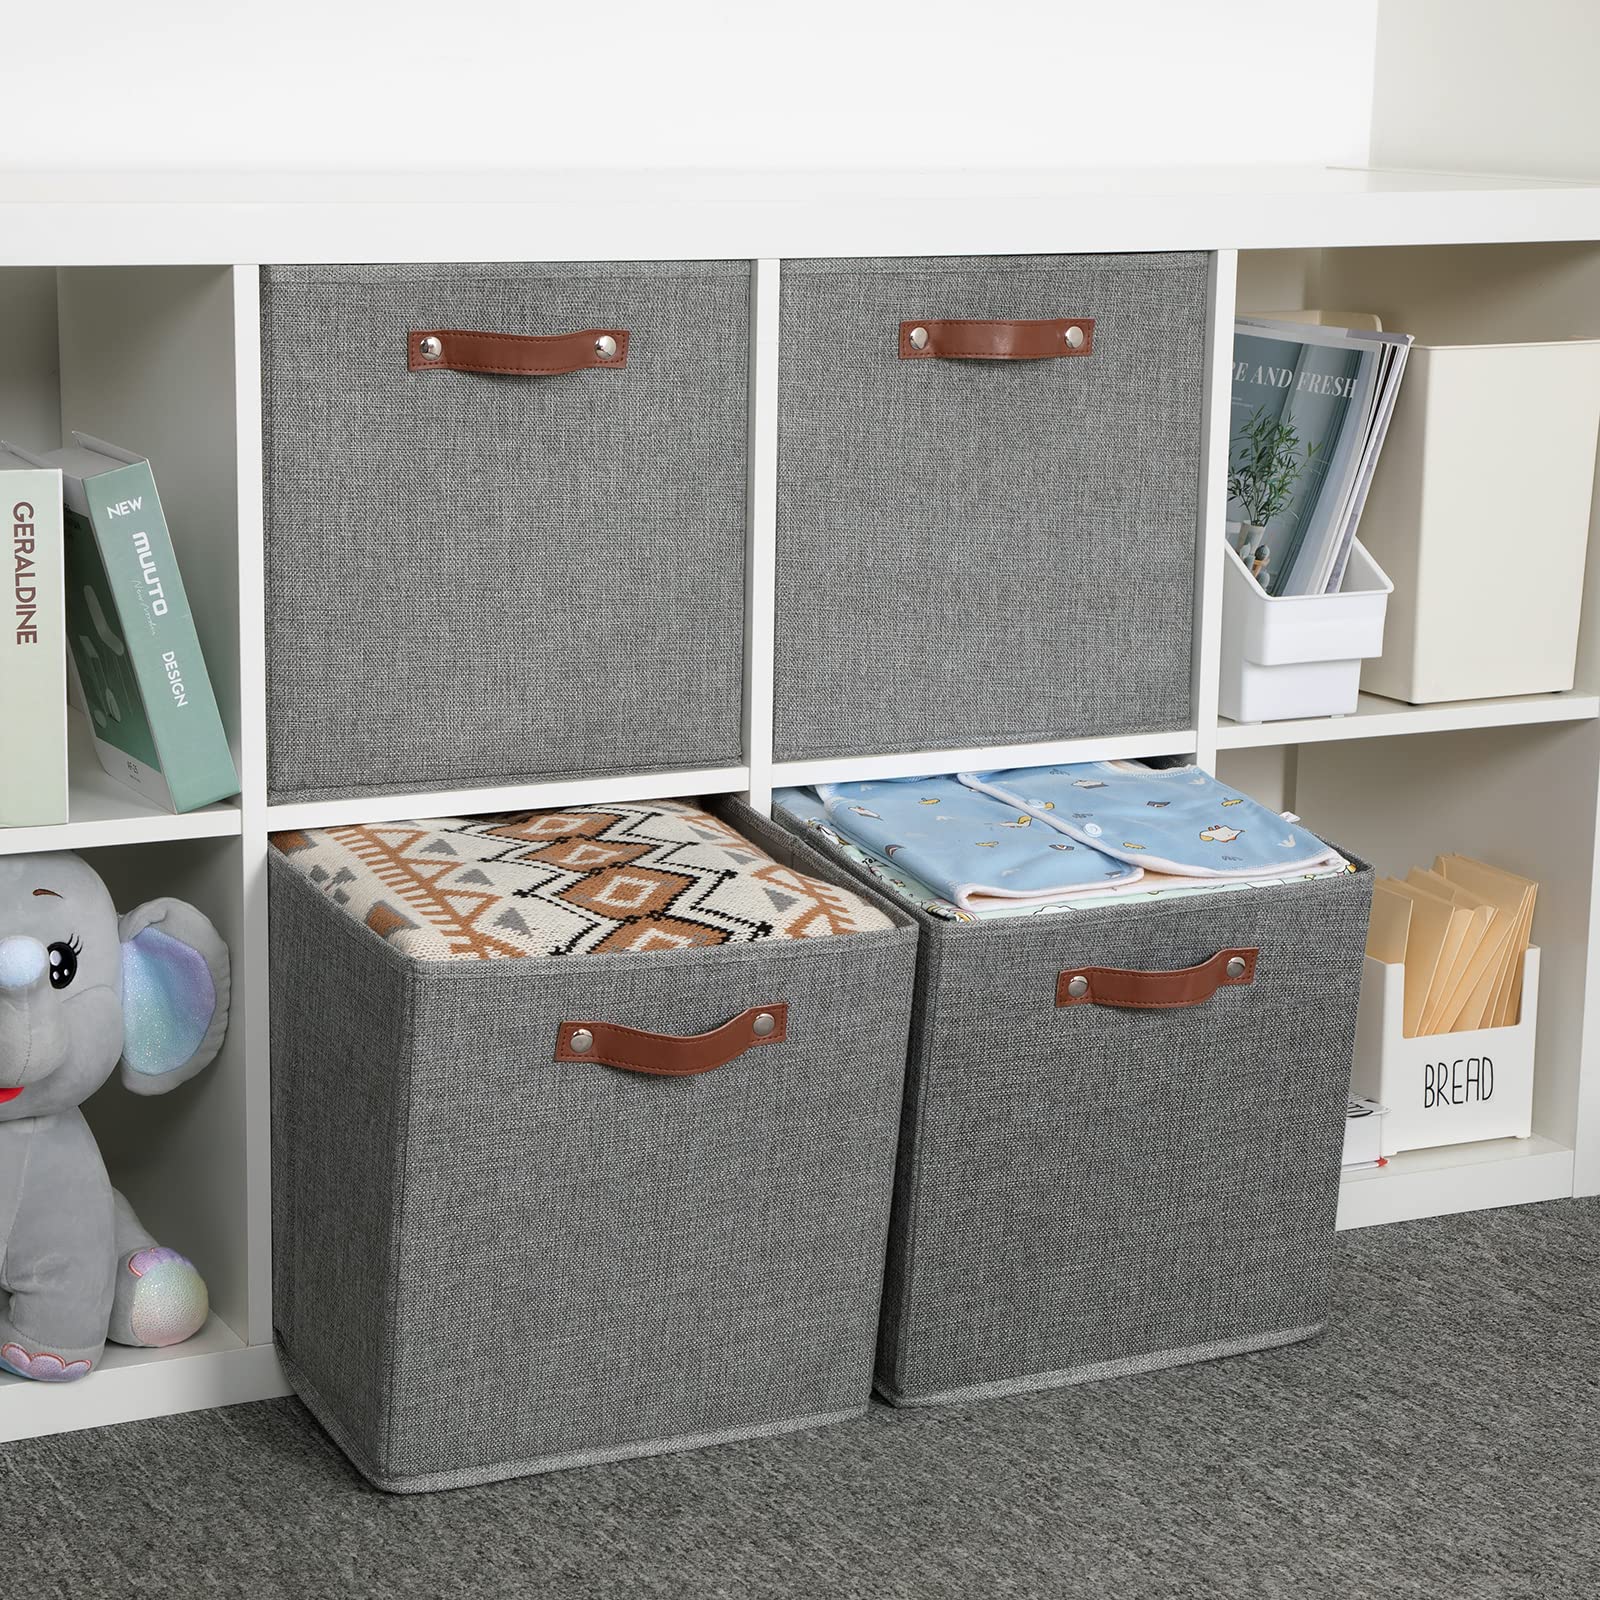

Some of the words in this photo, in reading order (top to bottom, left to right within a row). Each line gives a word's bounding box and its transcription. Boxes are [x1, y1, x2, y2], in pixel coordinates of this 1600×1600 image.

[1250, 365, 1293, 388] AND
[1295, 371, 1358, 399] FRESH
[106, 496, 142, 519] NEW
[13, 501, 38, 645] GERALDINE
[162, 651, 188, 707] DESIGN
[1424, 1057, 1494, 1109] BREAD
